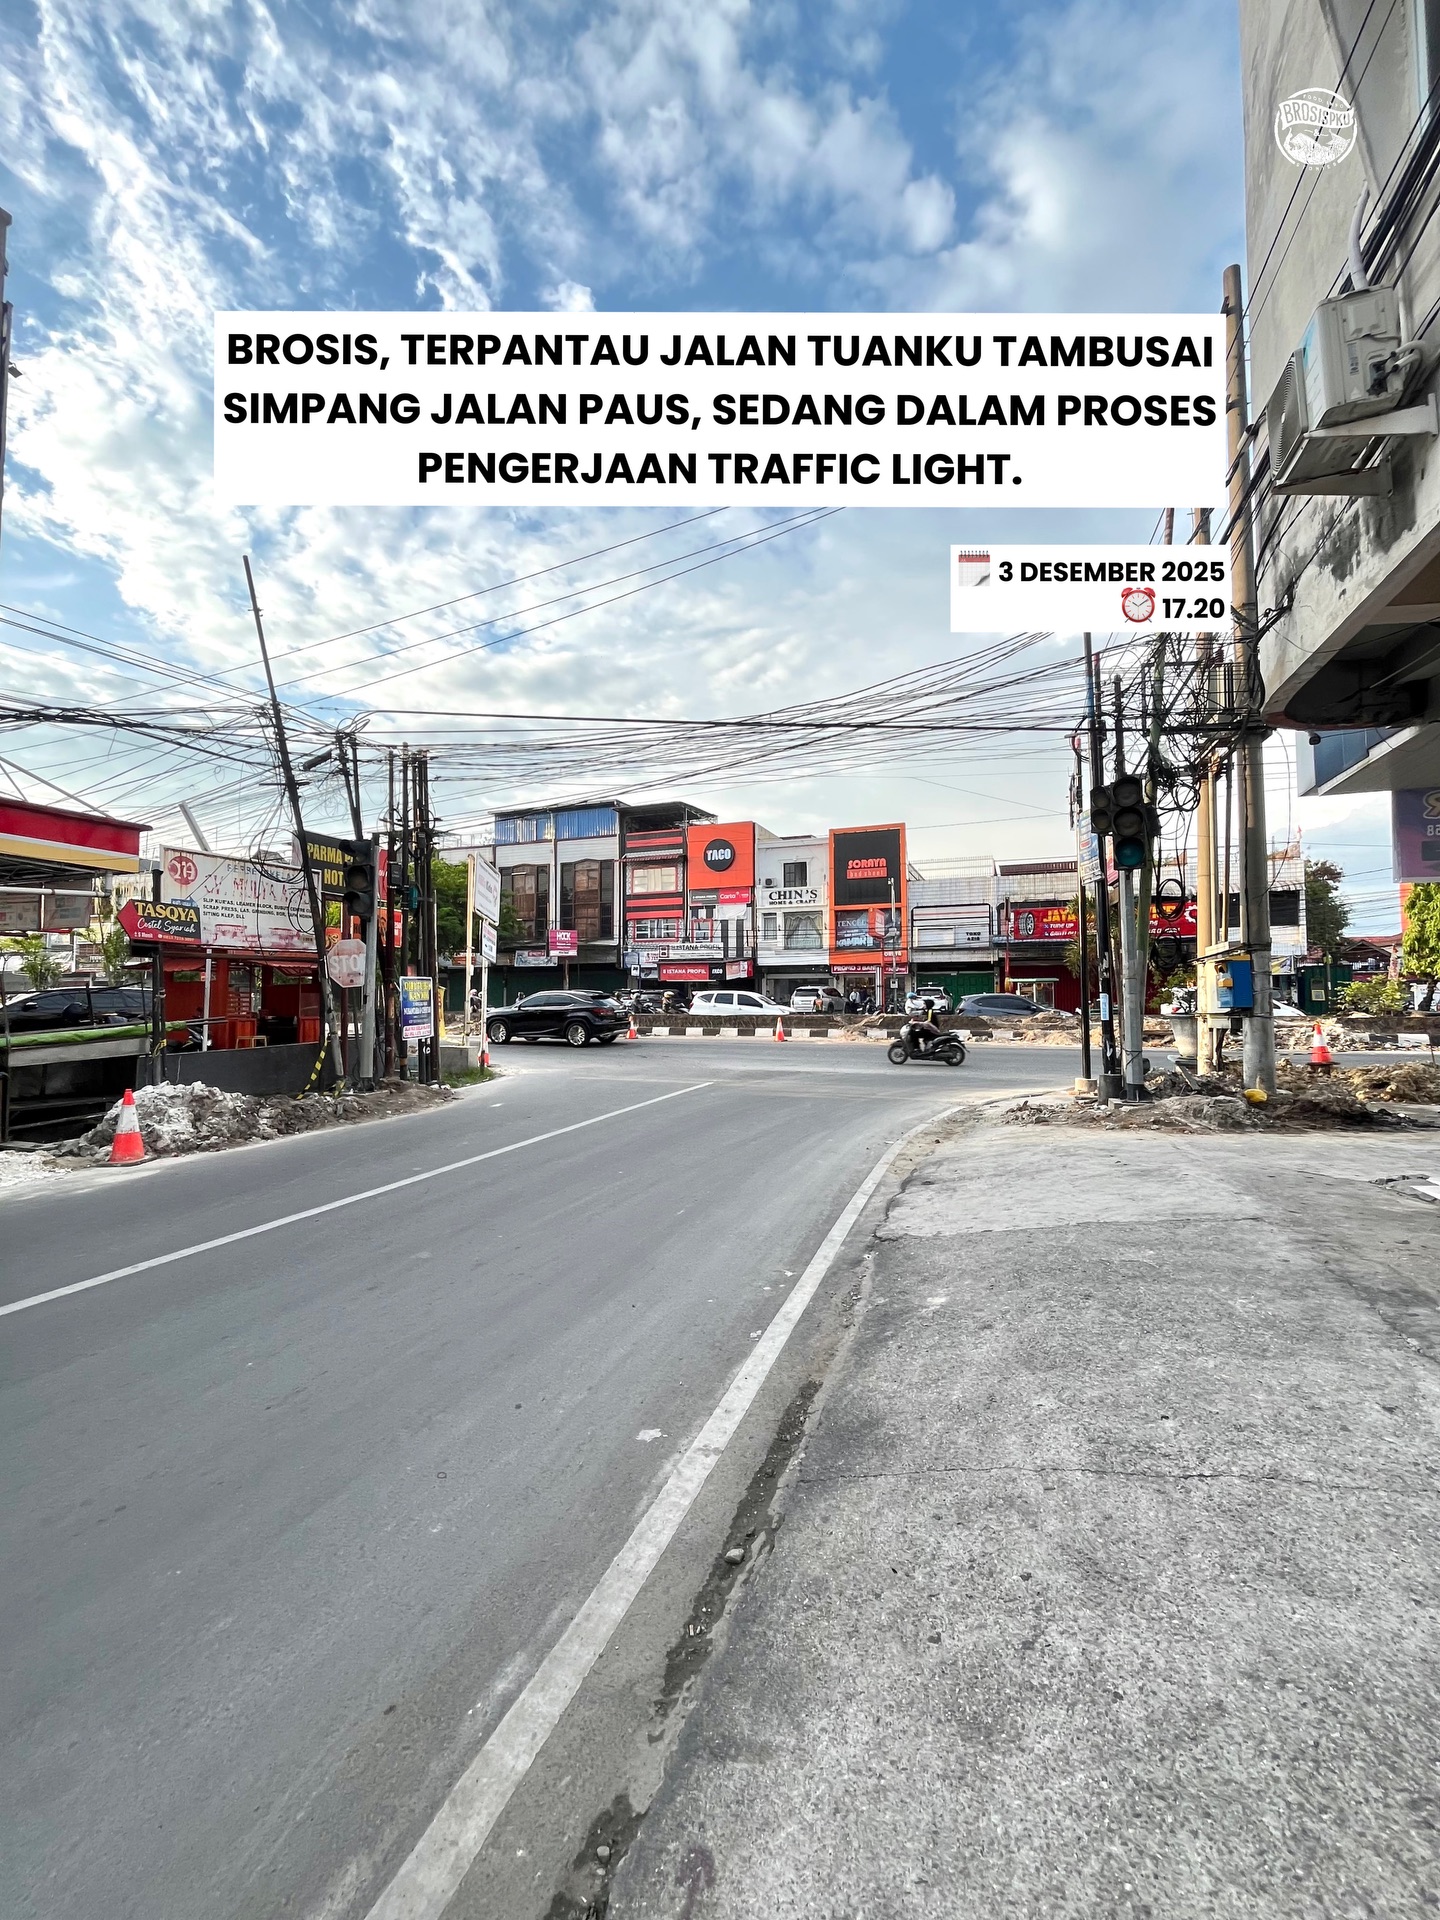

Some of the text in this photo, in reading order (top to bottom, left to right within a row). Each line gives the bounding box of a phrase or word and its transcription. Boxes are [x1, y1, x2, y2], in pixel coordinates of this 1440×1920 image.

[307, 843, 342, 864] PARMA
[706, 848, 731, 861] TACO
[848, 858, 886, 869] SORAYA
[324, 868, 345, 887] HOT
[769, 889, 818, 900] CHIN'S
[135, 902, 198, 922] TASQYA
